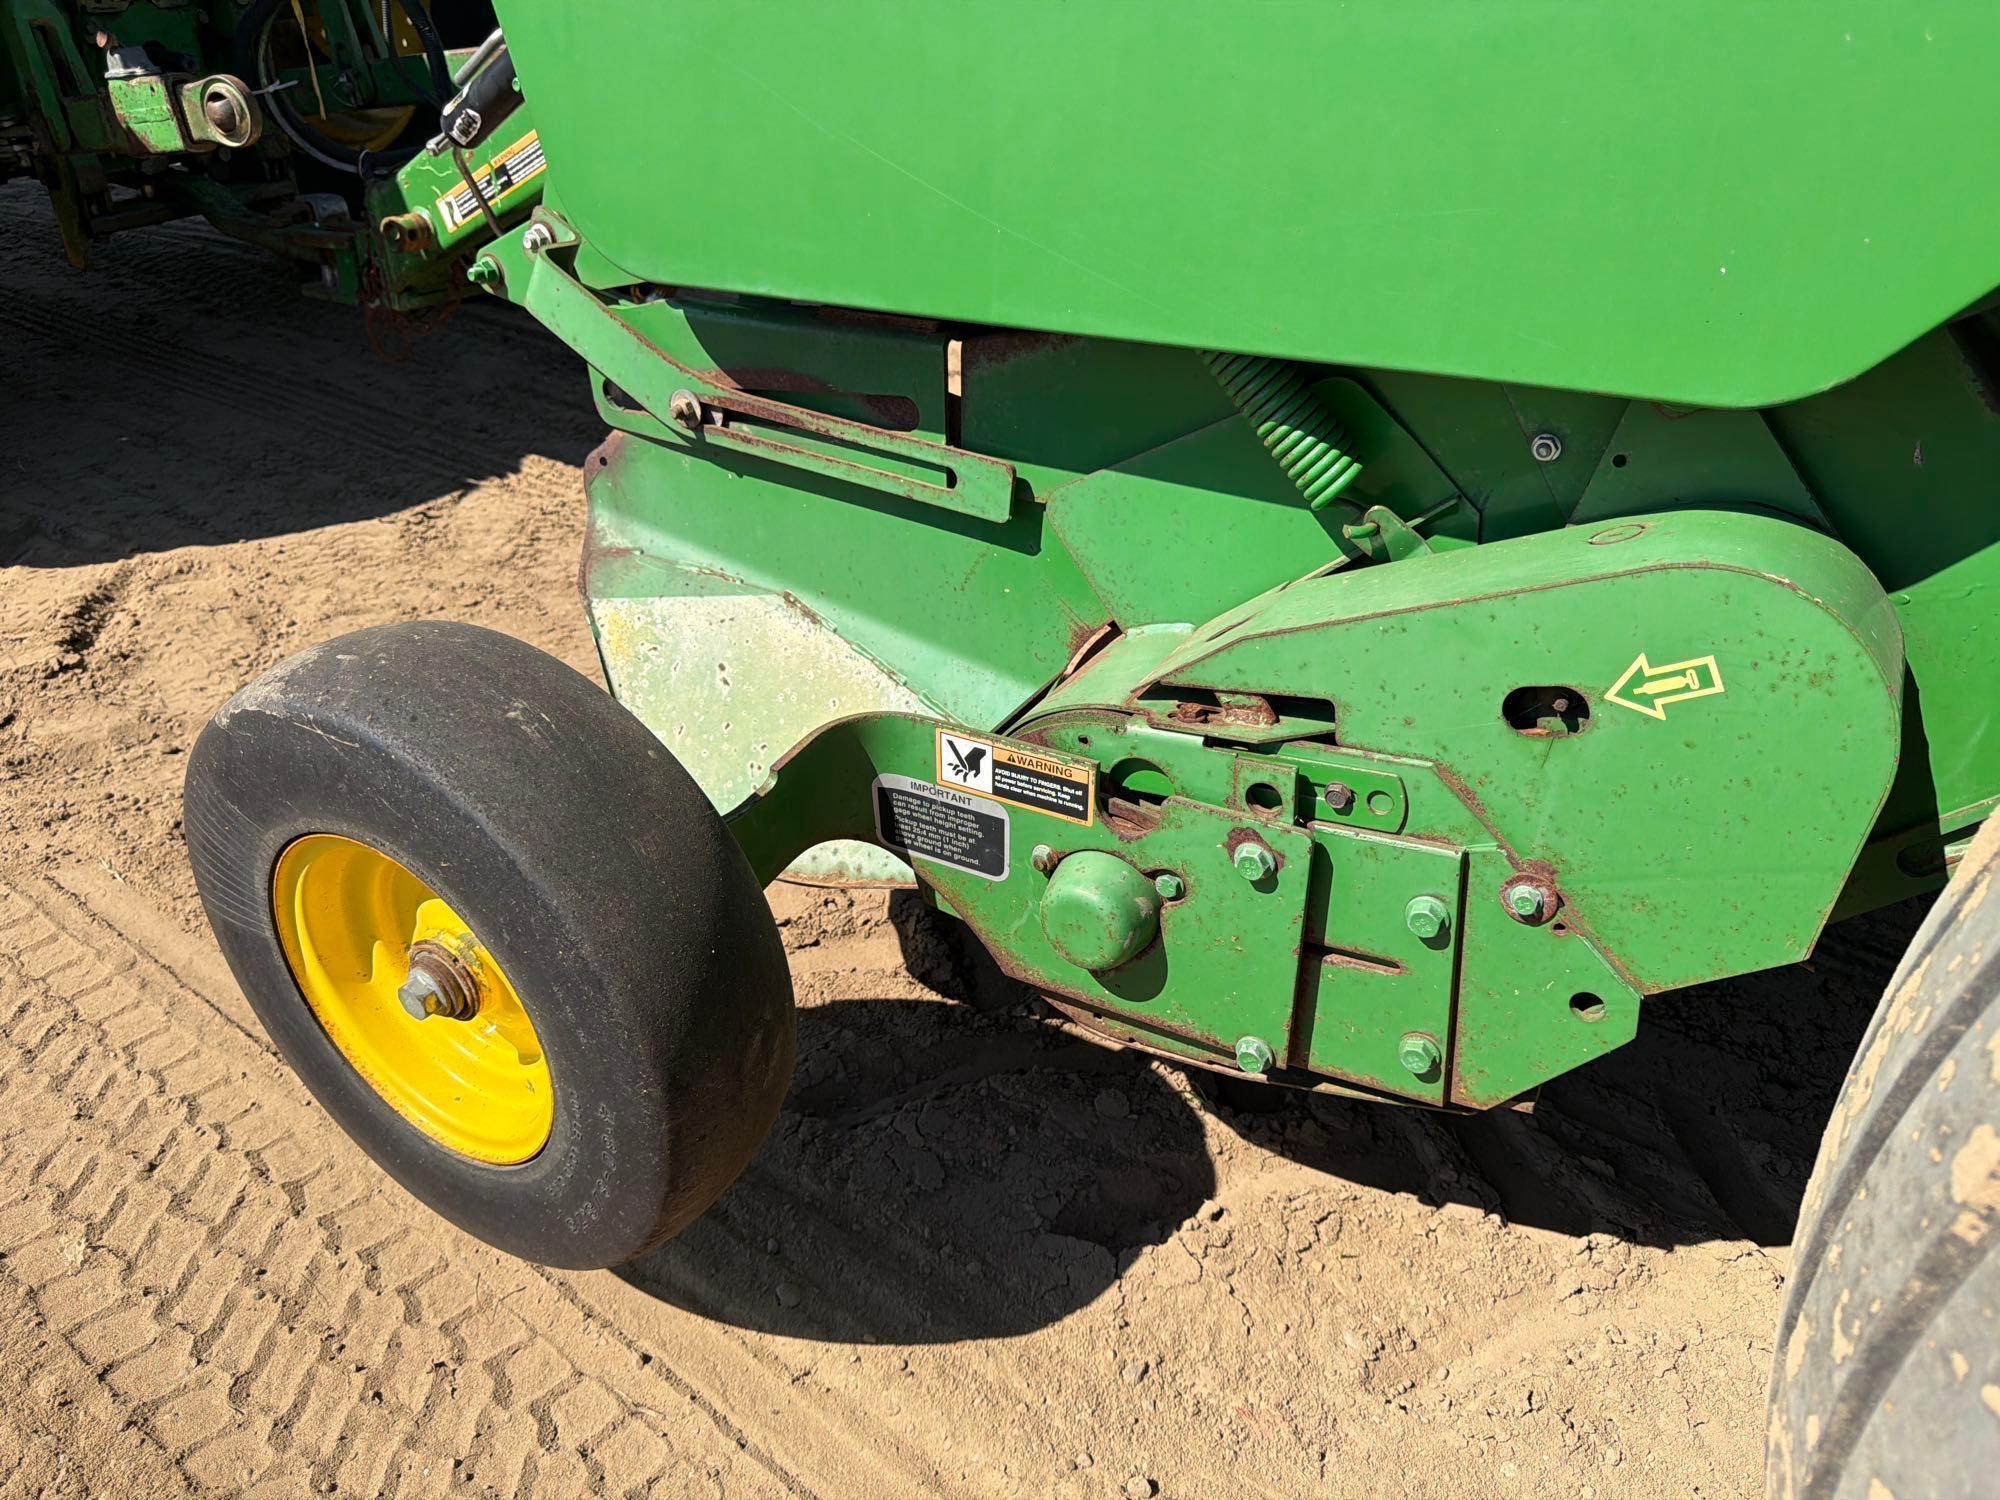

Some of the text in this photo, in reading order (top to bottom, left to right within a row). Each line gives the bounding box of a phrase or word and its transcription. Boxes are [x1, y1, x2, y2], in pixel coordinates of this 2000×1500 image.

[1016, 755, 1072, 777] WARNING
[910, 780, 972, 806] IMPORTANT
[995, 768, 1010, 777] AVOID
[1011, 771, 1030, 782] INJURY
[1062, 786, 1075, 795] Shut
[1001, 777, 1016, 786] power
[1016, 780, 1033, 790] before
[1057, 791, 1071, 801] Keep
[892, 792, 975, 821] Damage to pickup teeth
[994, 781, 1010, 790] hands
[1023, 789, 1036, 797] when
[1036, 793, 1057, 803] machine
[1063, 801, 1084, 811] running.
[893, 807, 985, 838] gage wheel height setting.
[894, 814, 918, 827] Pickup
[919, 821, 937, 833] teeth
[938, 828, 956, 838] must
[957, 831, 967, 841] be
[907, 802, 928, 813] result
[929, 808, 946, 819] from
[947, 813, 980, 829] improper
[894, 822, 970, 851] least 25.4 mm (1 inch)
[895, 828, 962, 854] above ground when
[895, 835, 981, 866] gage wheel is on ground.
